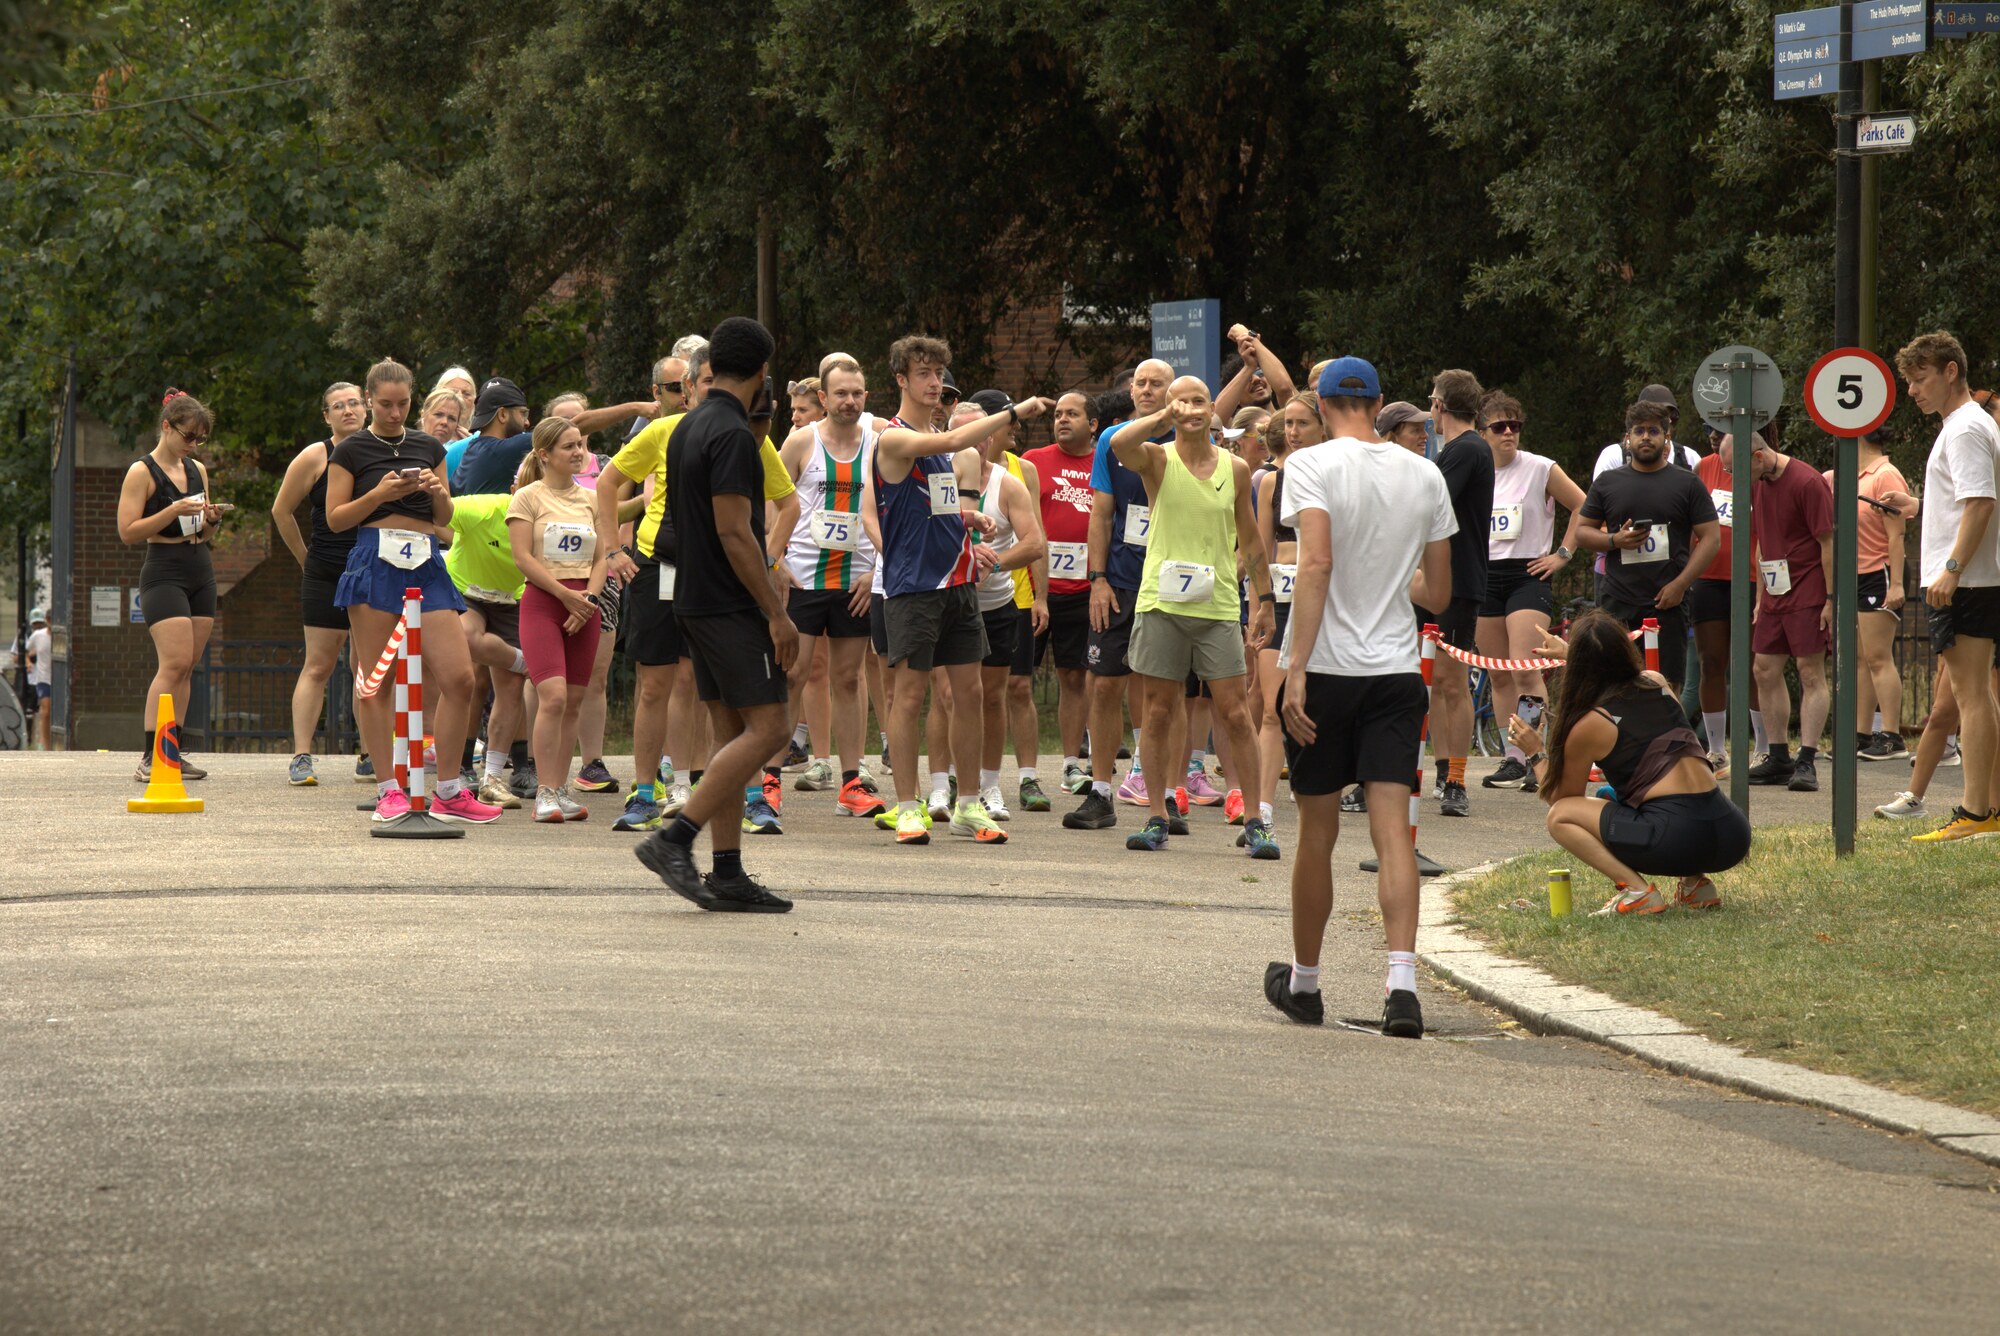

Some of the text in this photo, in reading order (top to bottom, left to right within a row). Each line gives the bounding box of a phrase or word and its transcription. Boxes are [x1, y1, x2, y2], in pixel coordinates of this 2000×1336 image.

[1870, 9, 1878, 19] The
[1899, 1, 1922, 17] Playground
[1796, 21, 1806, 31] Gate
[1892, 32, 1921, 48] Sports Pavilion
[1787, 50, 1803, 63] Olympic
[1803, 48, 1812, 59] Park
[1787, 79, 1805, 91] Greenway
[1886, 124, 1905, 140] Café
[1155, 334, 1187, 351] Victoria Park
[1837, 375, 1863, 410] 5
[1061, 469, 1091, 480] IMMY
[940, 486, 956, 504] 78
[1055, 489, 1093, 500] LONDON
[1063, 486, 1089, 494] EAST
[1490, 515, 1509, 532] 19
[824, 523, 848, 541] 75
[400, 542, 413, 559] 4
[558, 535, 582, 552] 49
[1051, 554, 1075, 570] 72
[1179, 574, 1193, 593] 7
